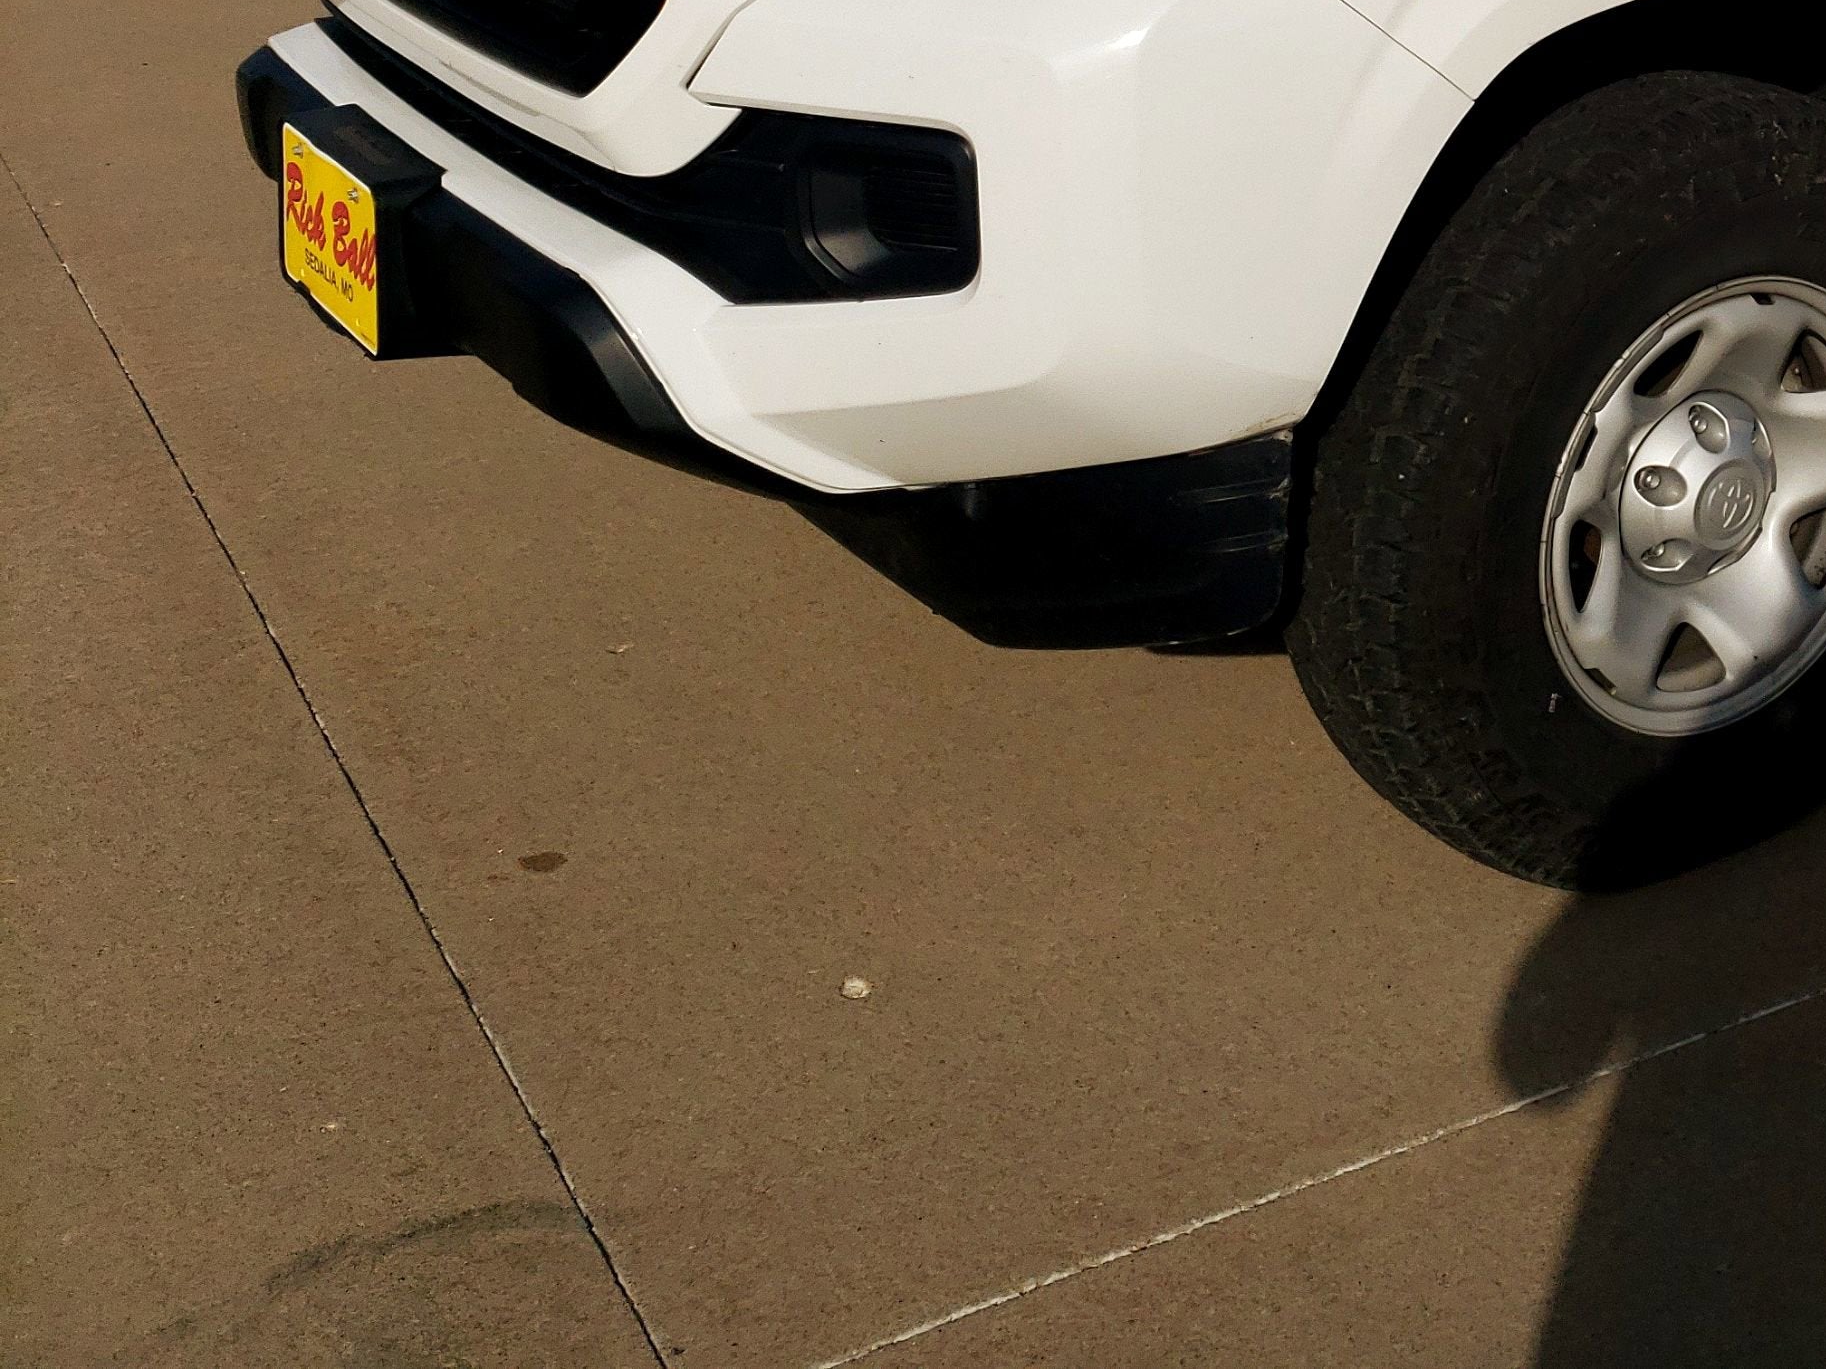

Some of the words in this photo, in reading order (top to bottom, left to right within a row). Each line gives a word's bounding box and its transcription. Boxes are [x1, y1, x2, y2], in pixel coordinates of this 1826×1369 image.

[286, 161, 327, 252] Rick
[331, 201, 376, 292] Ball
[304, 247, 340, 293] SEDALIA,
[340, 277, 354, 303] MO
